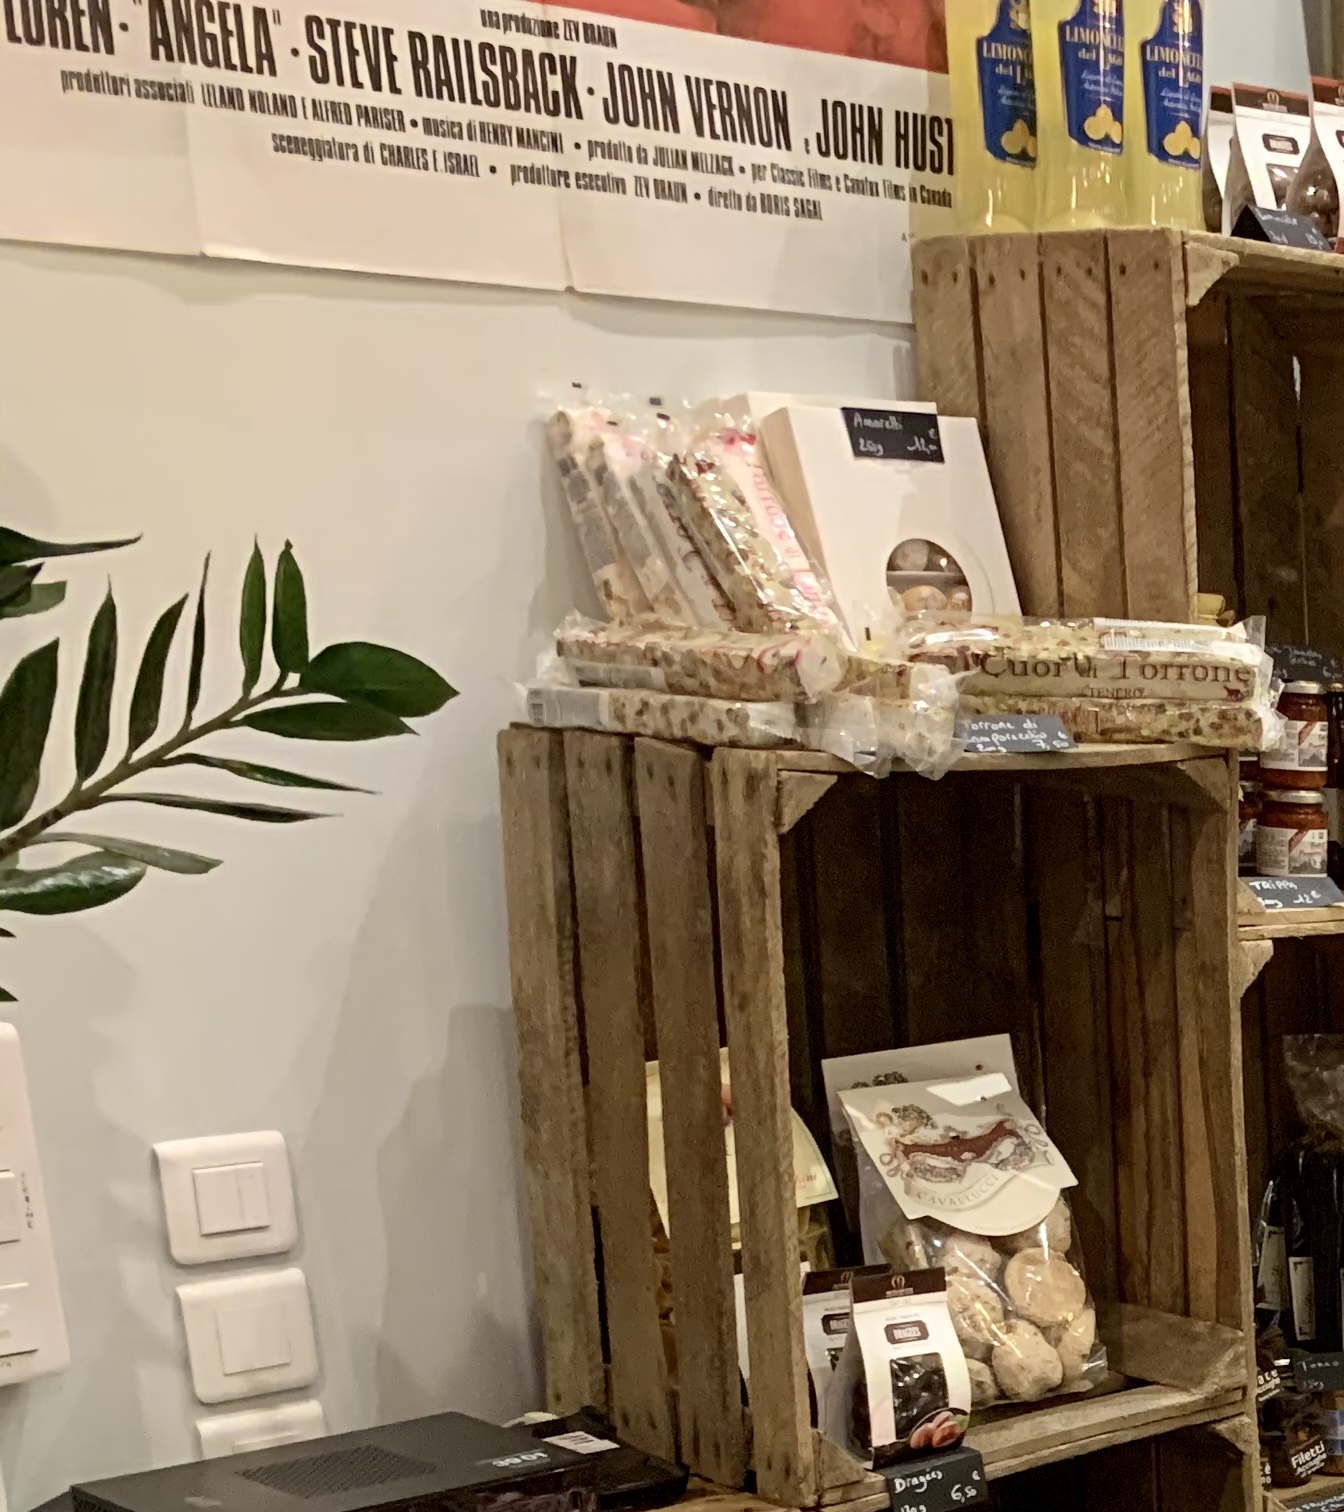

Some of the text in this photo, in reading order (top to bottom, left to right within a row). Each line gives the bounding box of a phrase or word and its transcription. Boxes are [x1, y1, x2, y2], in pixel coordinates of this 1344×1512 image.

[501, 12, 560, 39] produzione
[562, 18, 581, 41] ZEV
[582, 21, 618, 49] BRAUN
[3, 0, 116, 55] LOREN
[304, 14, 402, 95] STEVE
[407, 30, 584, 120] RAILSBACK
[602, 61, 681, 134] JOHN
[684, 75, 792, 152] VERNON
[816, 98, 883, 166] JOHN
[60, 69, 132, 97] produttori
[133, 77, 196, 104] associati
[200, 82, 246, 112] LELAND
[248, 89, 298, 119] NOLAND
[311, 99, 353, 126] ALFRED
[356, 104, 406, 133] PARISER
[422, 115, 464, 141] musica
[466, 120, 478, 143] di
[479, 120, 514, 148] HENRY
[515, 126, 565, 154] MANCINI
[652, 145, 689, 171] JULIAN
[751, 163, 768, 185] per
[920, 185, 953, 209] Canada
[271, 132, 359, 163] sceneggiatura
[362, 140, 376, 165] di
[379, 142, 430, 171] CHARLES
[509, 163, 572, 188] produttore
[575, 171, 627, 195] esecutivo
[633, 175, 650, 199] ZEV
[707, 186, 743, 212] diretto
[746, 191, 758, 214] da
[760, 192, 791, 217] BORIS
[793, 197, 823, 221] SAGAL
[979, 652, 1063, 680] Cuor
[1112, 655, 1251, 684] Torrone
[916, 1173, 1000, 1206] CAVALLUCCI
[1290, 1440, 1326, 1469] Filetti
